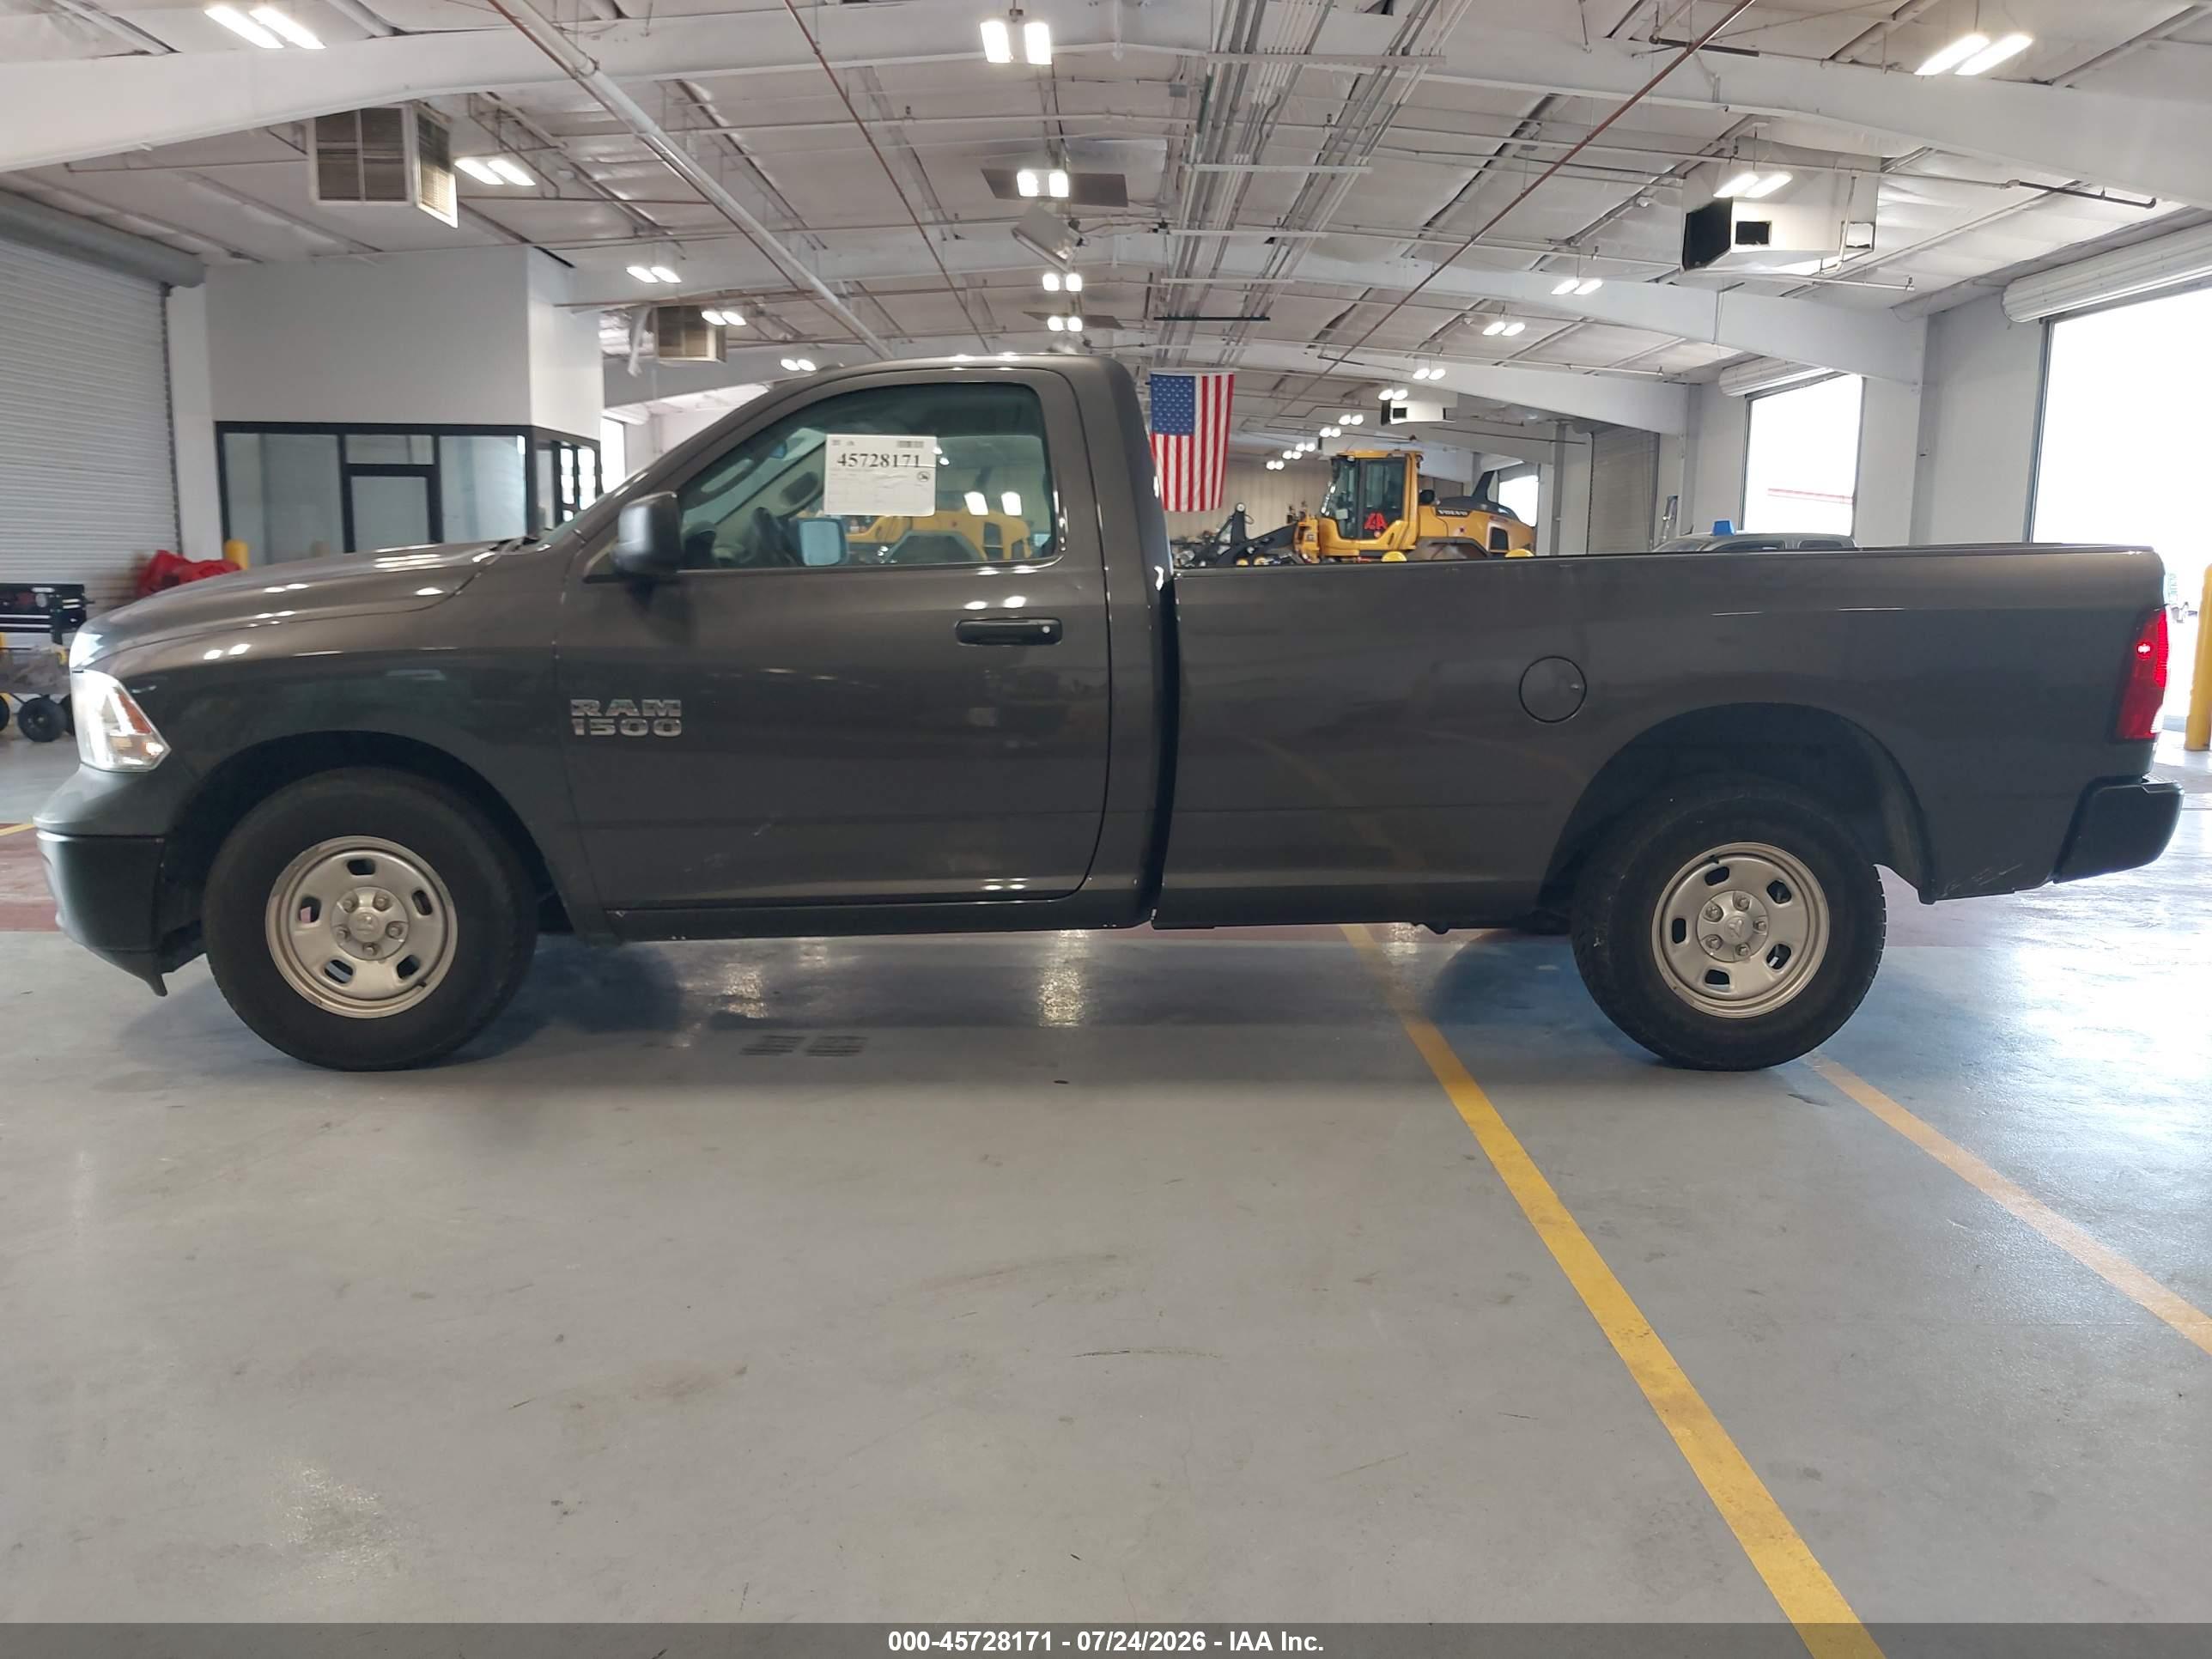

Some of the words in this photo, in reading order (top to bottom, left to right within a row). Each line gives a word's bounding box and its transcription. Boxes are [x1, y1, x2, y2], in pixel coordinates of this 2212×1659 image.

[837, 453, 920, 468] 45728171
[570, 698, 682, 717] RAM
[571, 718, 682, 738] 1500
